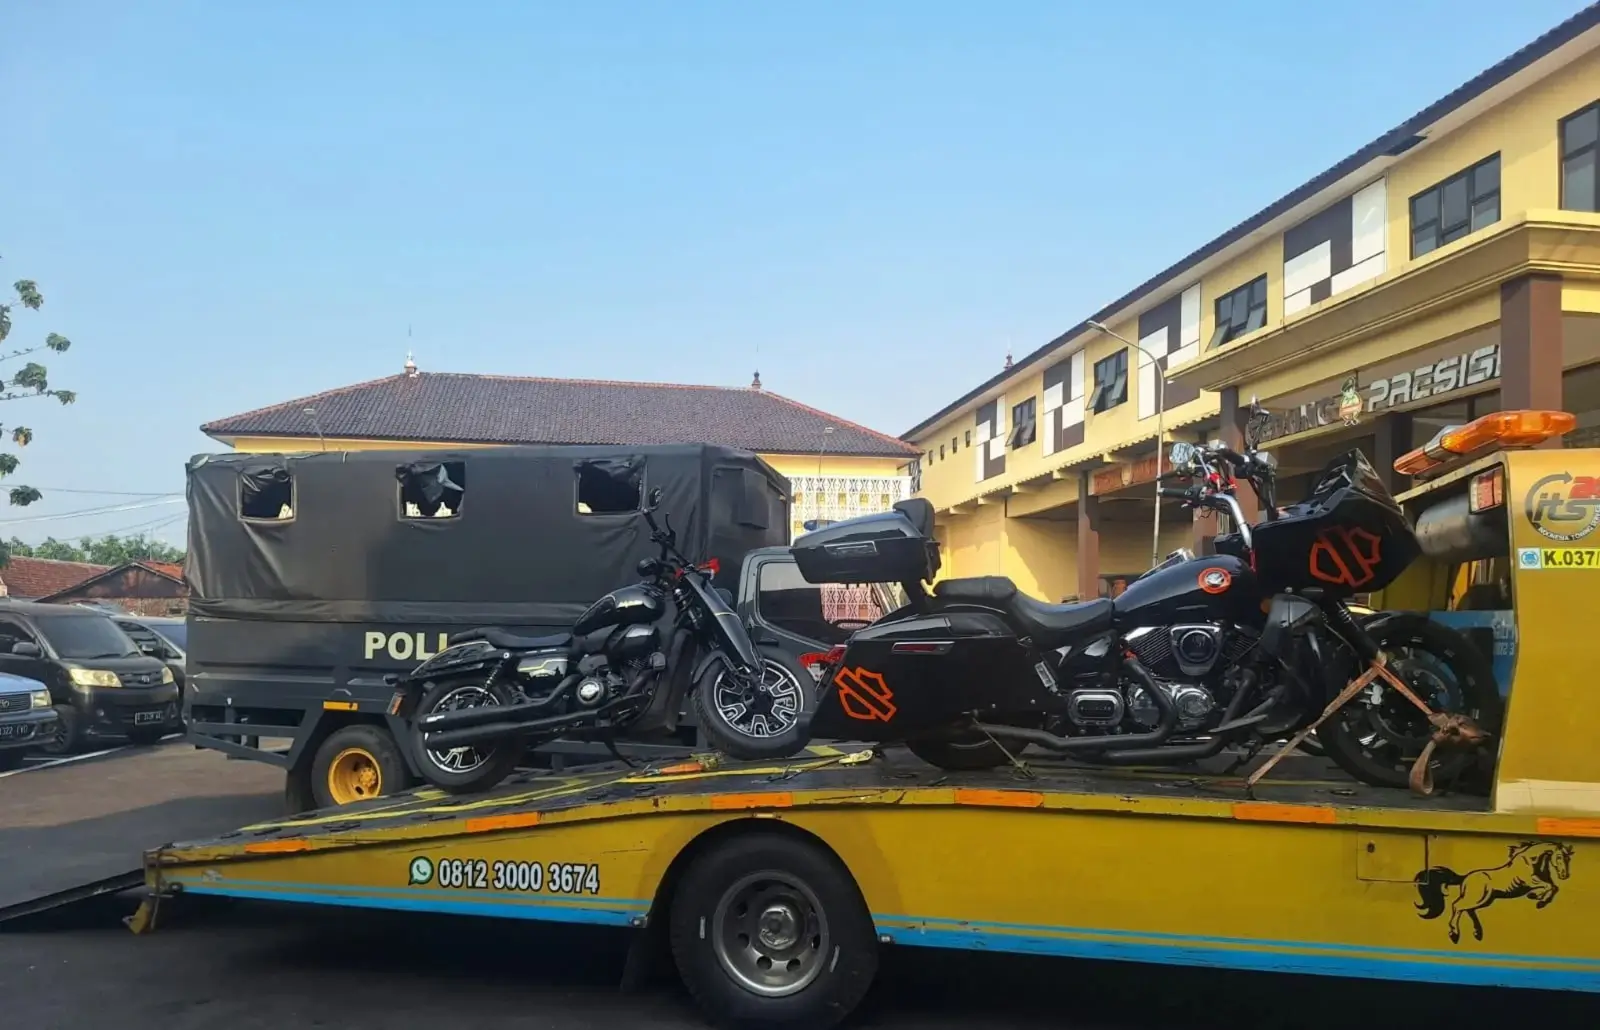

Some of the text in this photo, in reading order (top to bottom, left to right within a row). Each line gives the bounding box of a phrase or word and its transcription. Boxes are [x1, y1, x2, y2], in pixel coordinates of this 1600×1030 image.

[438, 858, 600, 895] 0812 3000 3674
